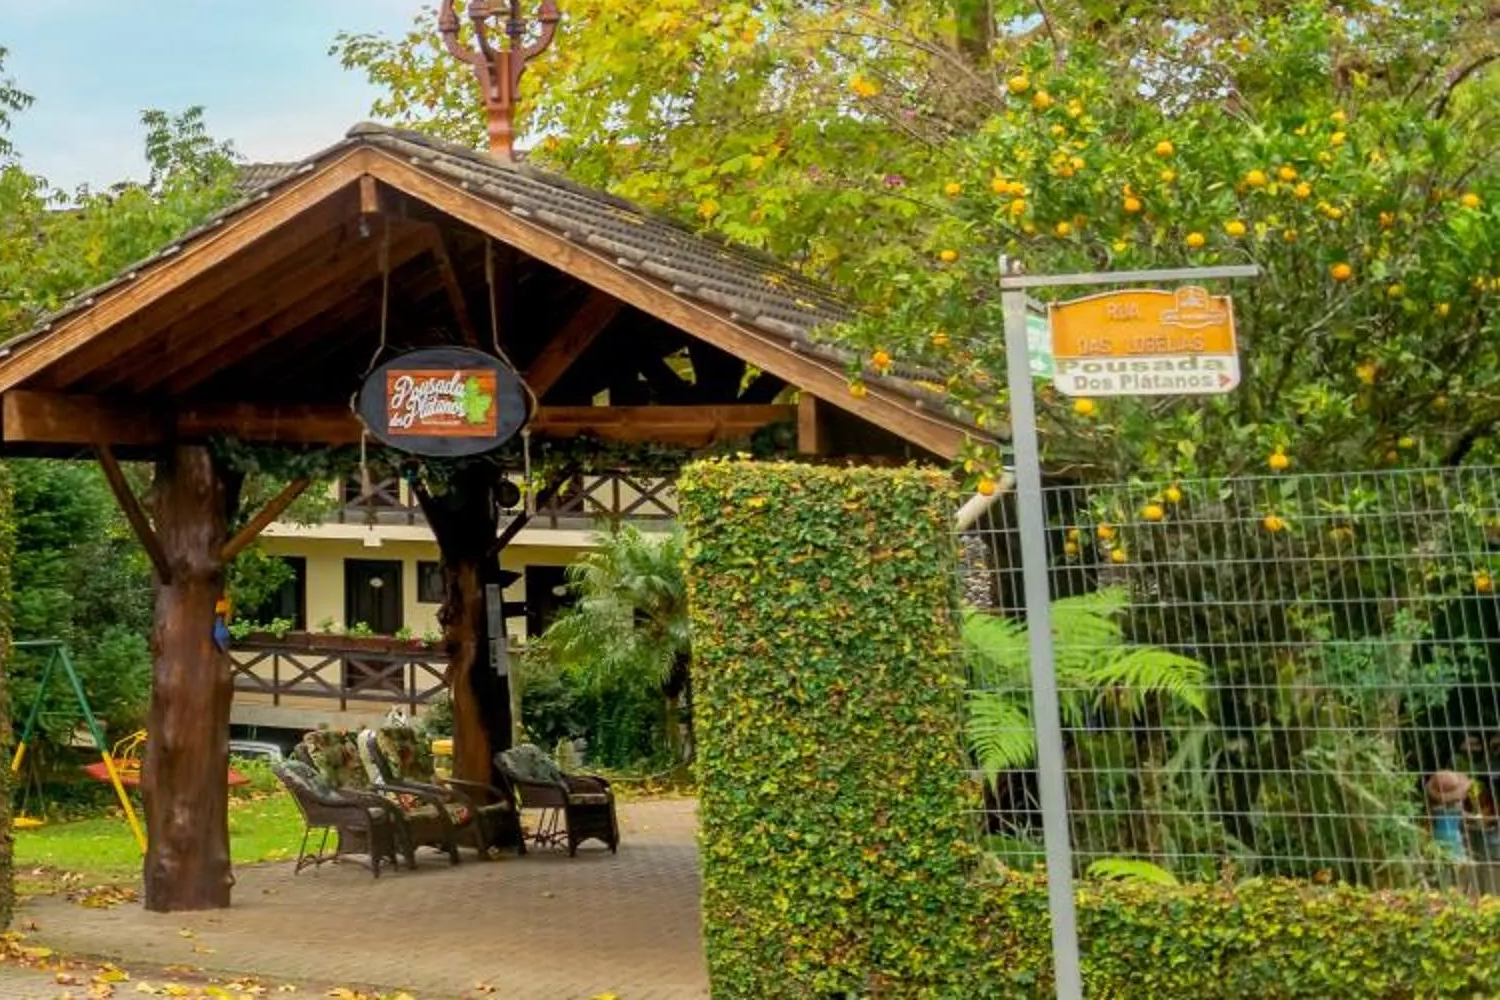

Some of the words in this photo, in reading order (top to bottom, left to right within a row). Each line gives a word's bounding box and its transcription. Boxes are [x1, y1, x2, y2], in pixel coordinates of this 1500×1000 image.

[1107, 303, 1141, 319] RUA
[1058, 356, 1227, 374] Pousada
[391, 371, 467, 408] Pousada
[1073, 375, 1113, 391] Dos
[1120, 373, 1214, 390] Plátanos
